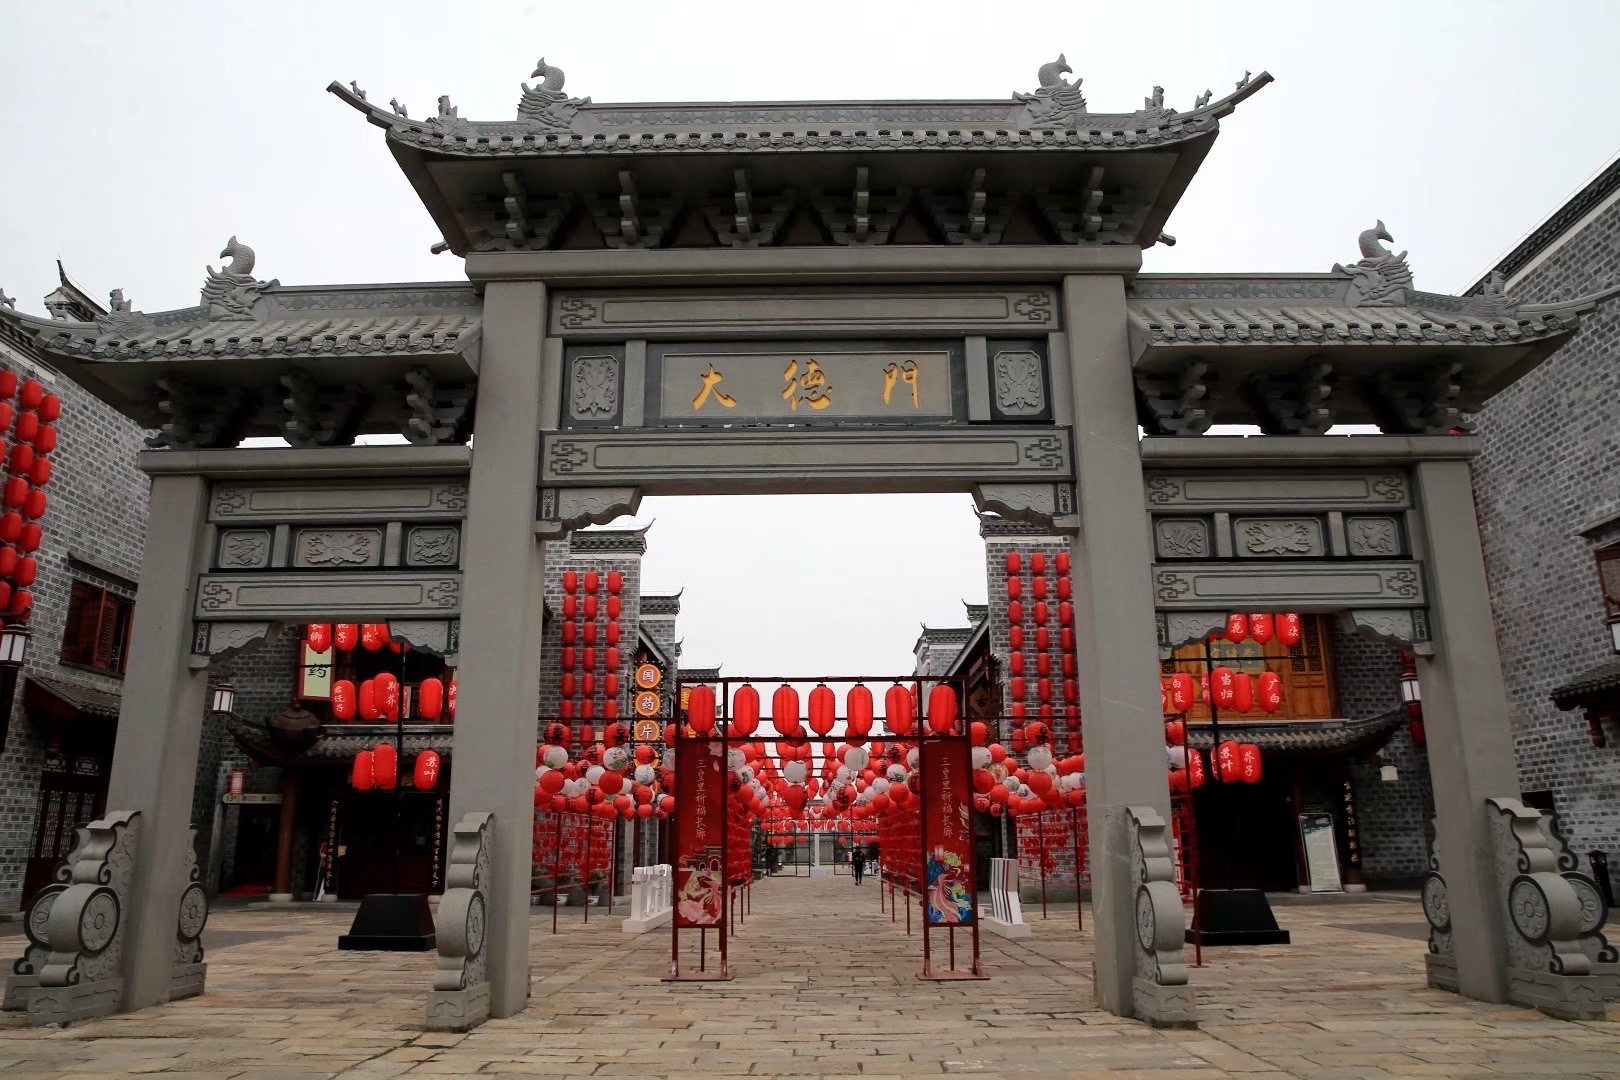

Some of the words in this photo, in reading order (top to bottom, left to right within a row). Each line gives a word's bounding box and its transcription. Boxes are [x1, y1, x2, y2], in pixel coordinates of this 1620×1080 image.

[1220, 674, 1233, 699] 当归
[423, 756, 437, 781] 苏叶
[1220, 747, 1233, 772] 苏叶
